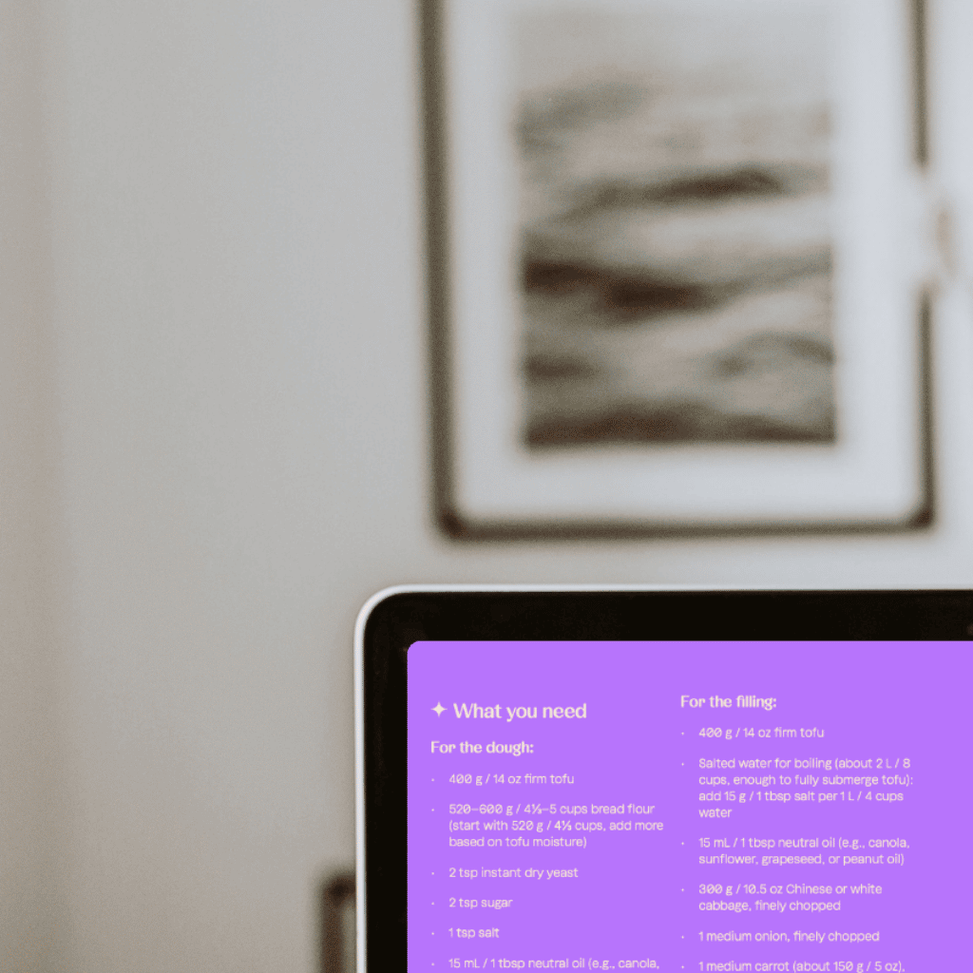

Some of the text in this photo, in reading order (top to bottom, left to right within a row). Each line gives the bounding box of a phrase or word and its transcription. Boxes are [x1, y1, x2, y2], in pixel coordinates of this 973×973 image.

[680, 695, 777, 711] For the filling:
[452, 703, 587, 722] What you need
[430, 741, 534, 757] For the dough:
[698, 774, 913, 787] cups, enough to fully submerge tofu):
[698, 808, 733, 818] water
[448, 836, 587, 848] based on tofu moisture)
[448, 867, 579, 880] 2 tsp instant dry yeast
[448, 897, 514, 909] 2 tsp sugar
[698, 900, 841, 913] cabbage, finely chopped
[448, 928, 500, 939] 1 tsp salt
[698, 930, 880, 943] 1 medium onion, finely chopped
